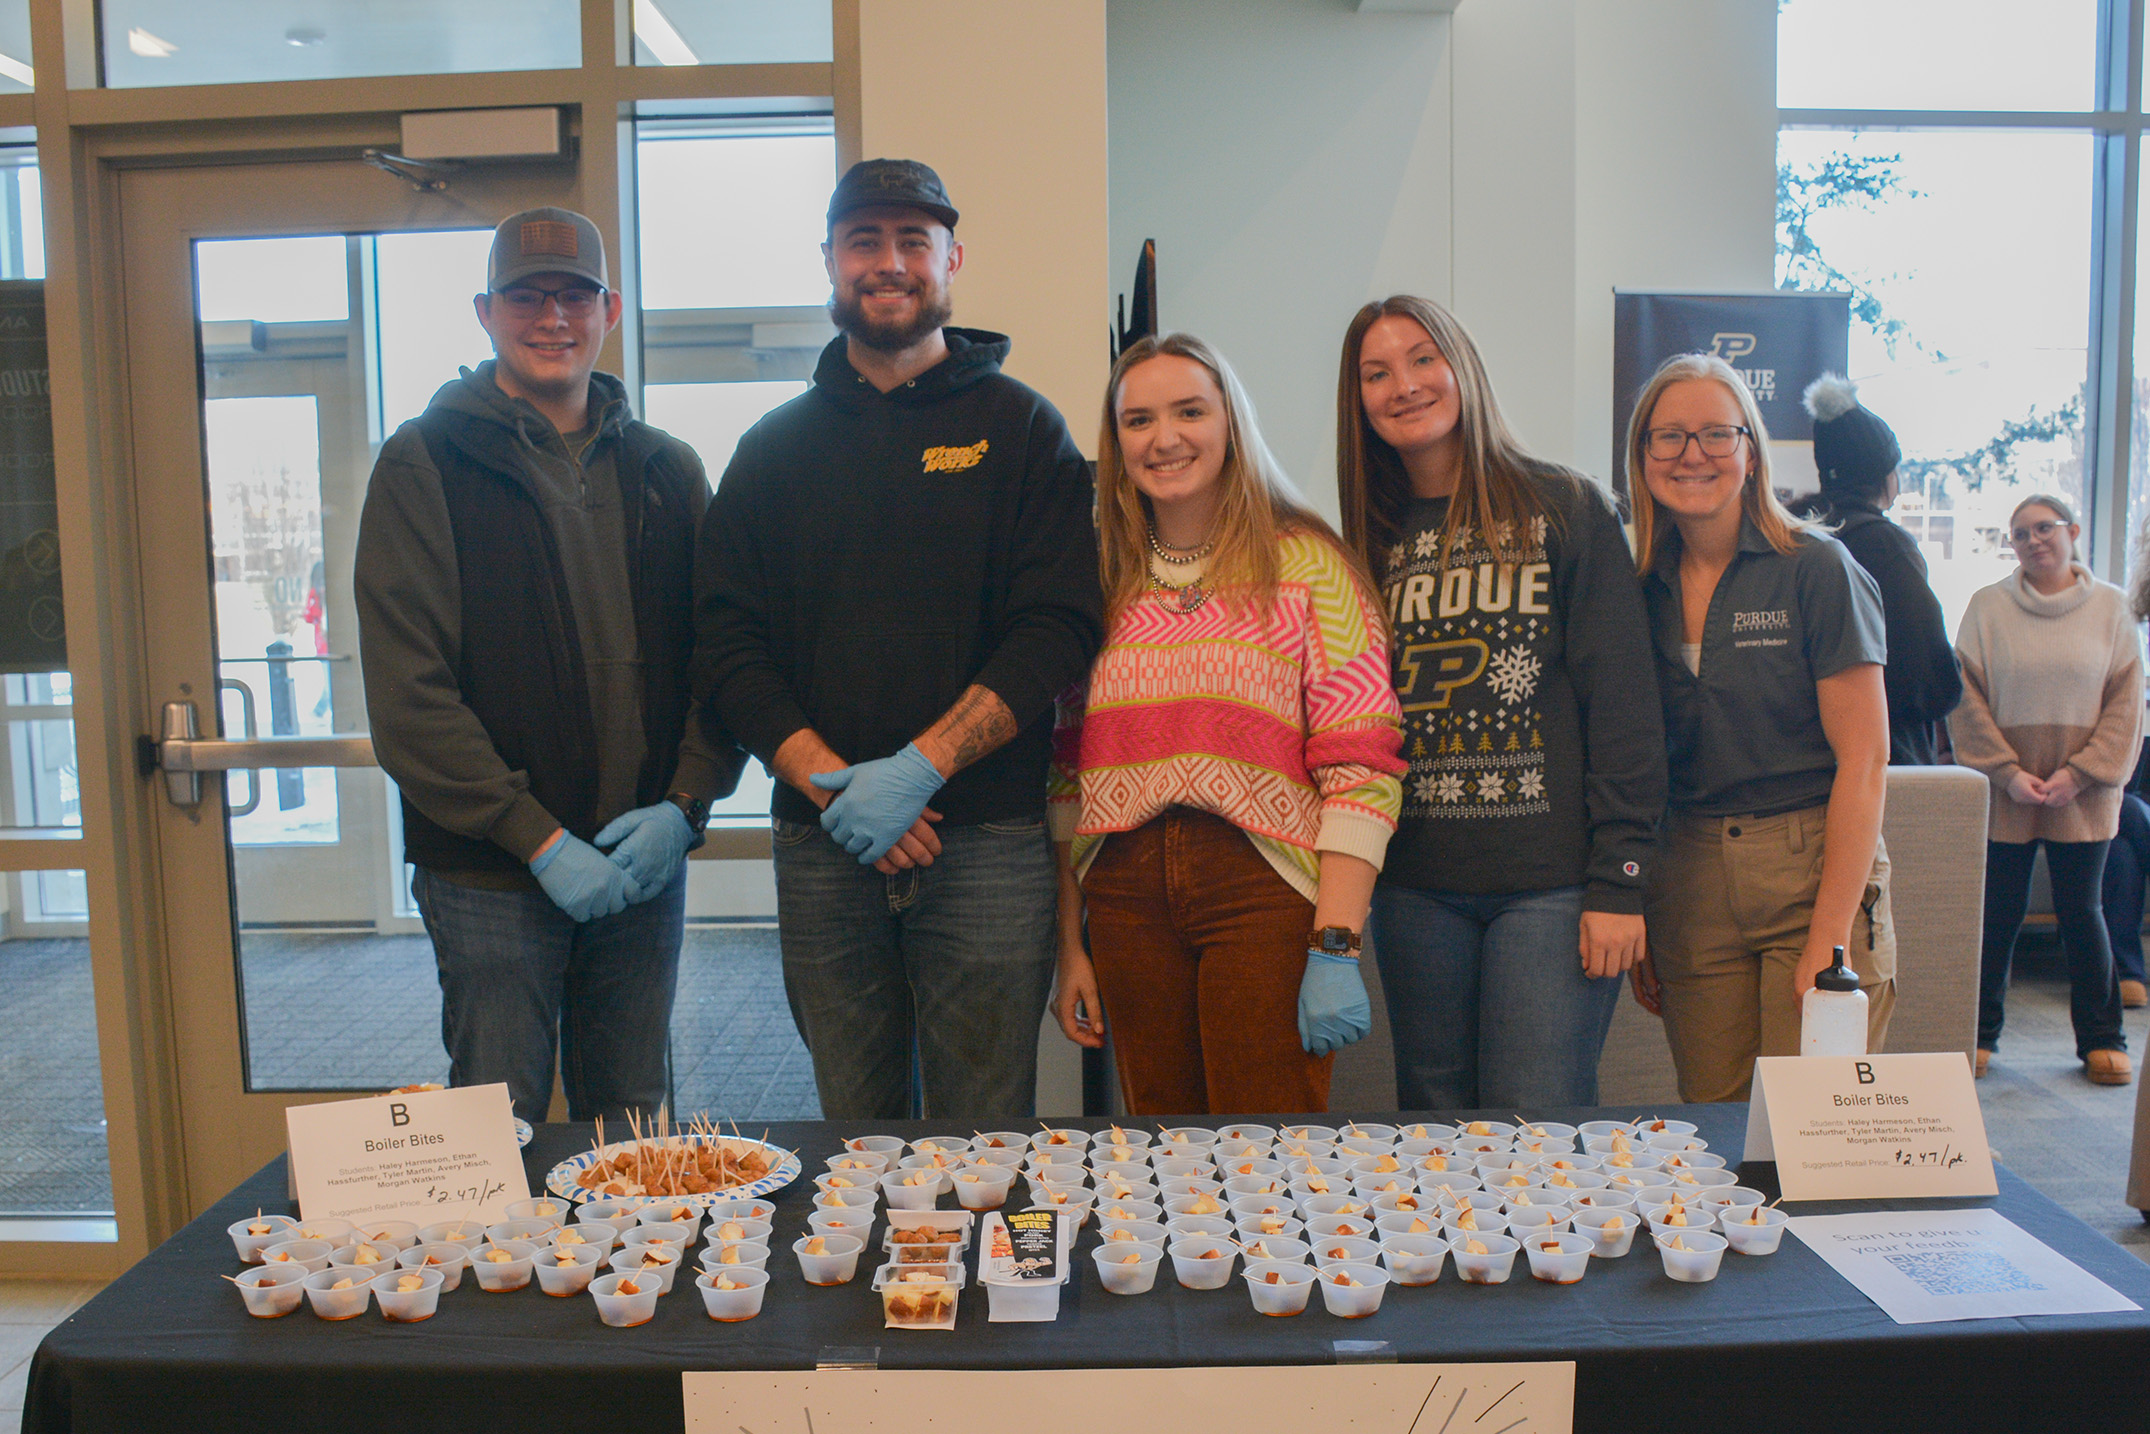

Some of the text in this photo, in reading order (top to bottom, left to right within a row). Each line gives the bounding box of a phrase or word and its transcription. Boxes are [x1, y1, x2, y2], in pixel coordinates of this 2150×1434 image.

[1734, 610, 1788, 625] PURDUE
[1855, 1062, 1875, 1084] B
[1832, 1093, 1909, 1107] Boiler Bites
[390, 1103, 410, 1127] B
[1847, 1118, 1870, 1127] Haley
[1872, 1117, 1916, 1126] Harmeson,
[1917, 1116, 1941, 1124] Ethan
[1799, 1125, 1956, 1137] Hassfurther, Tyler Martin, Avery Misch,
[364, 1132, 445, 1152] Boiler Bites
[1846, 1135, 1912, 1146] Morgan Watkins
[378, 1161, 403, 1170] Haley
[405, 1155, 451, 1168] Harmeson,
[452, 1152, 477, 1161] Ethan
[1801, 1161, 1844, 1171] Suggested
[1844, 1160, 1867, 1168] Retail
[327, 1159, 492, 1187] Hassfurther, Tyler Martin, Avery Misch,
[377, 1174, 446, 1190] Morgan Watkins
[328, 1204, 373, 1218] Suggested
[374, 1201, 399, 1212] Retail
[1008, 1213, 1053, 1223] BOILER
[1014, 1221, 1051, 1229] BITES
[1832, 1232, 1885, 1242] Scan
[1888, 1231, 1913, 1239] to
[1917, 1229, 1962, 1239] give
[1850, 1244, 1899, 1255] your
